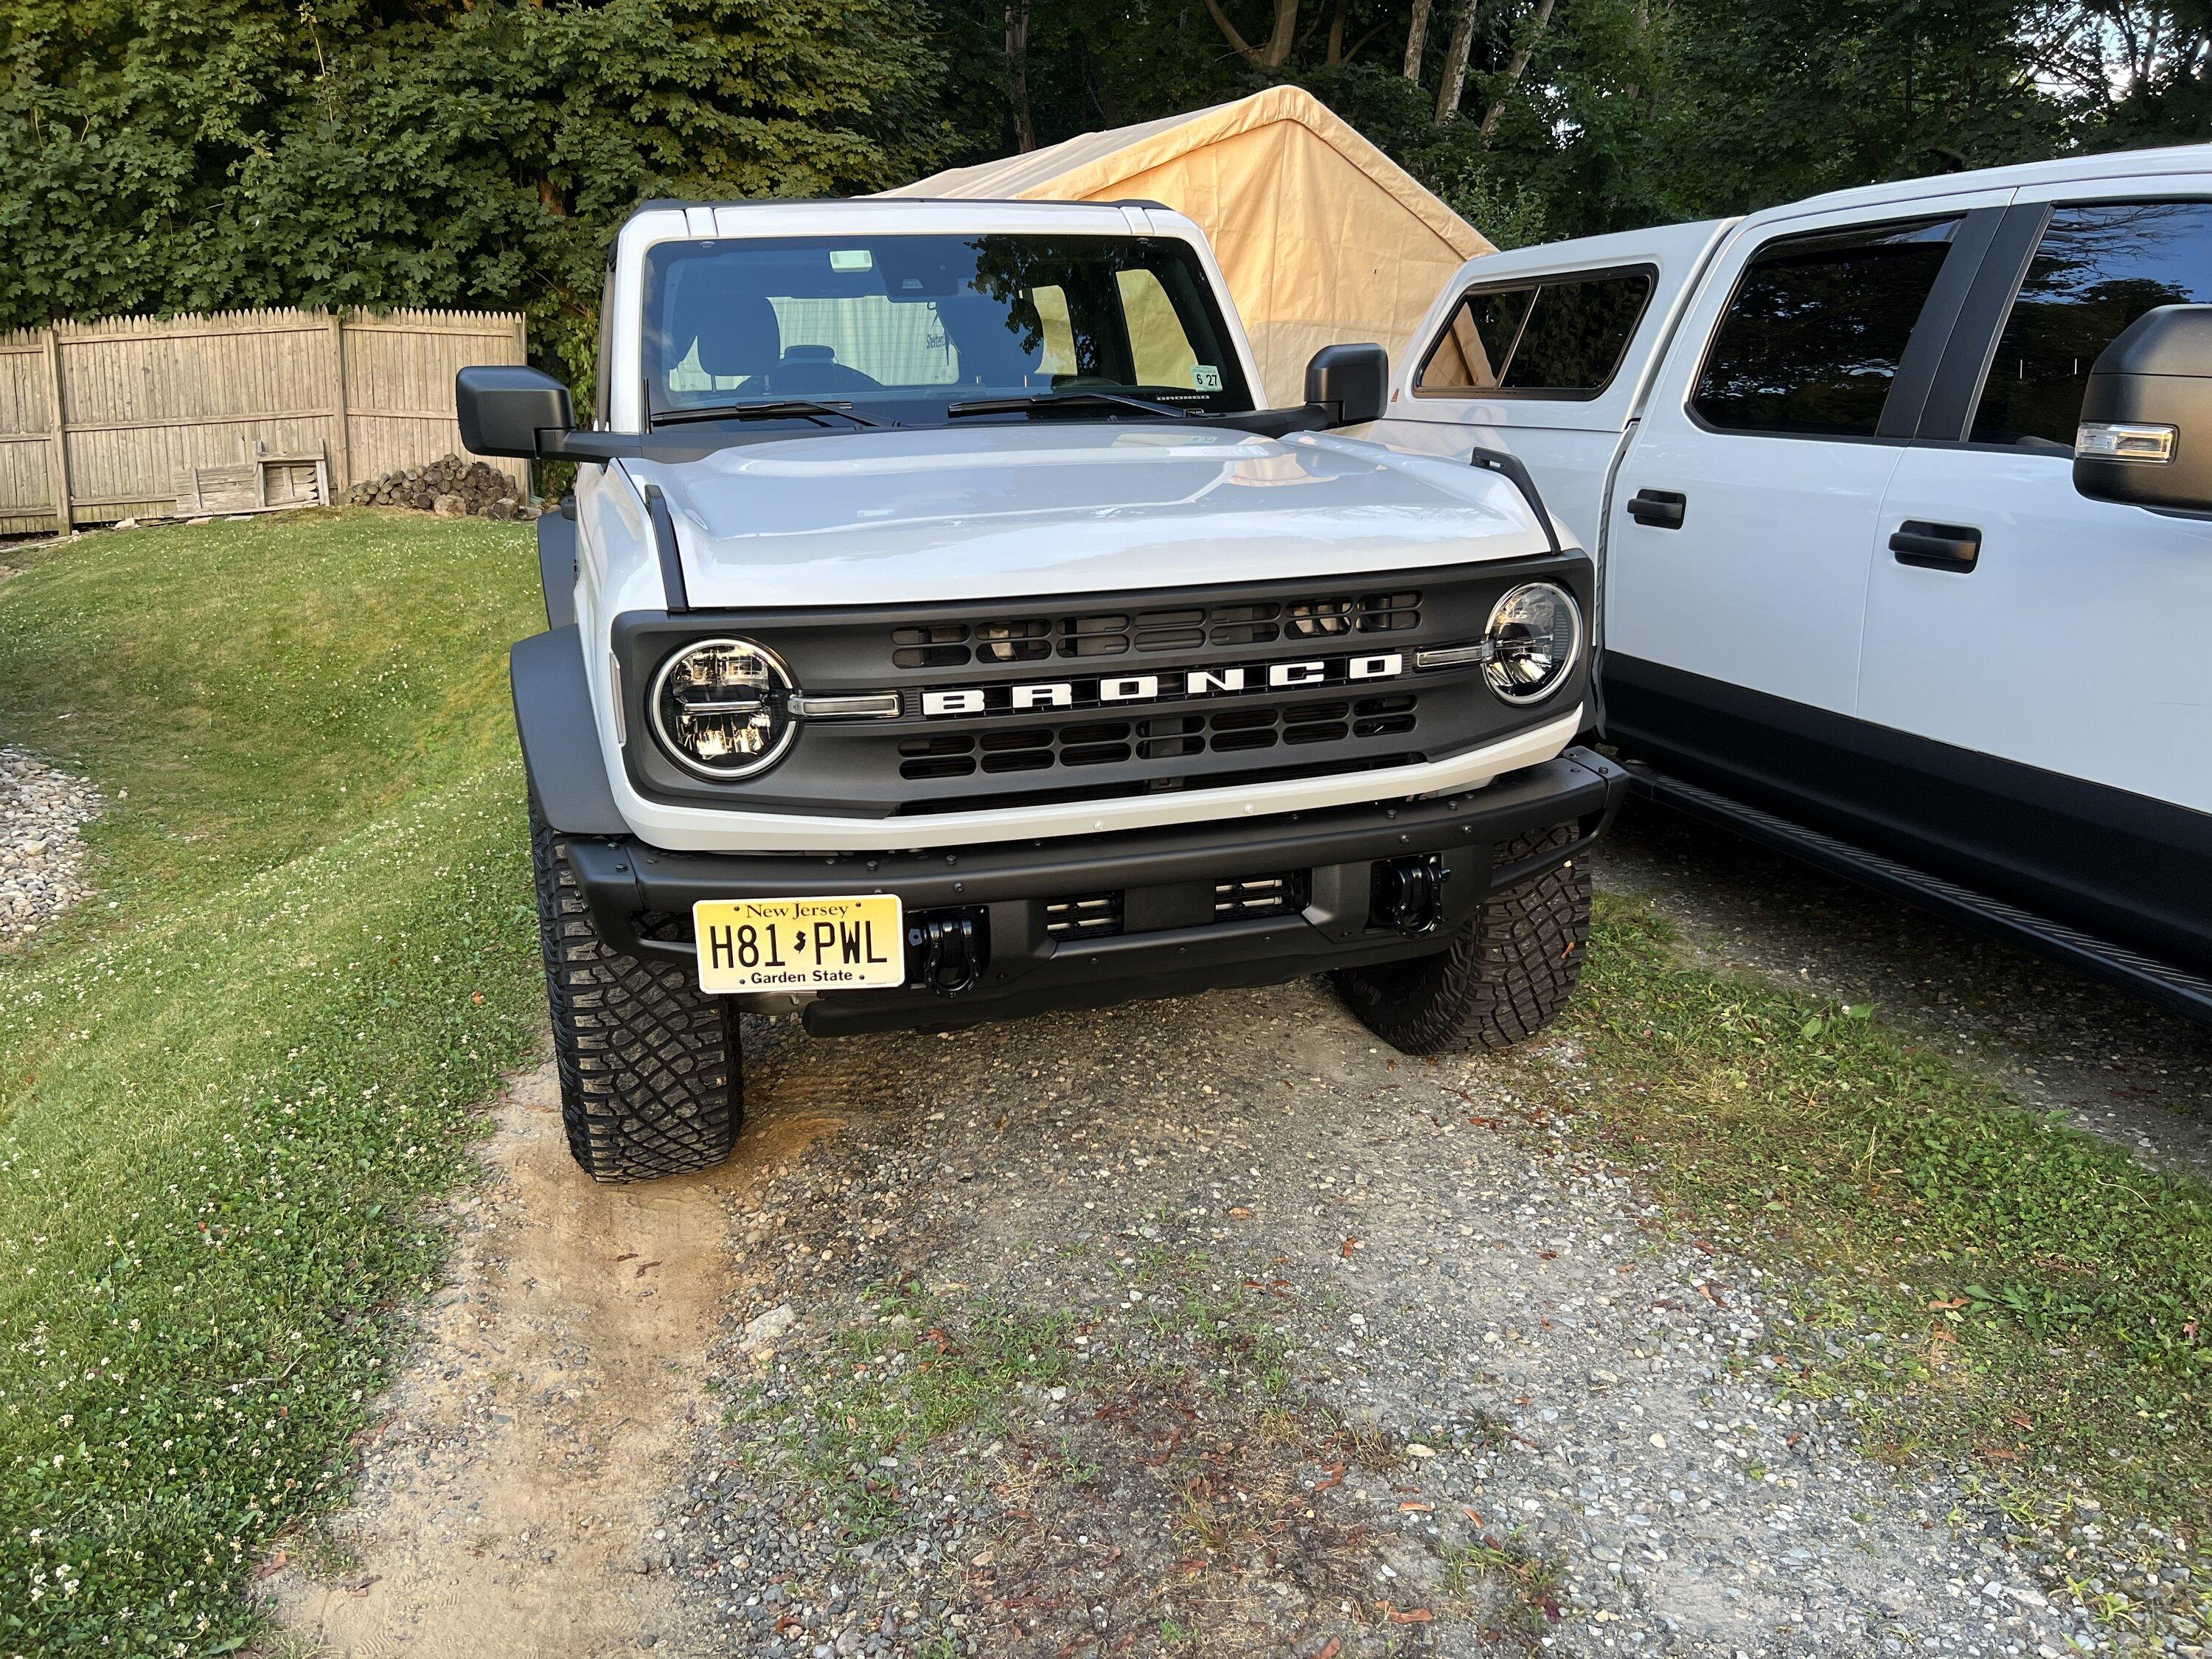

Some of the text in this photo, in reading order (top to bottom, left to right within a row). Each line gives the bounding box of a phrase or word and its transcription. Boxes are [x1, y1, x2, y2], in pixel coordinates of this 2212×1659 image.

[1197, 374, 1217, 387] 6 27
[922, 653, 1402, 715] BRONCO
[745, 900, 849, 920] New Jersey
[709, 920, 888, 969] H81 PWL
[751, 970, 853, 984] Garden State
